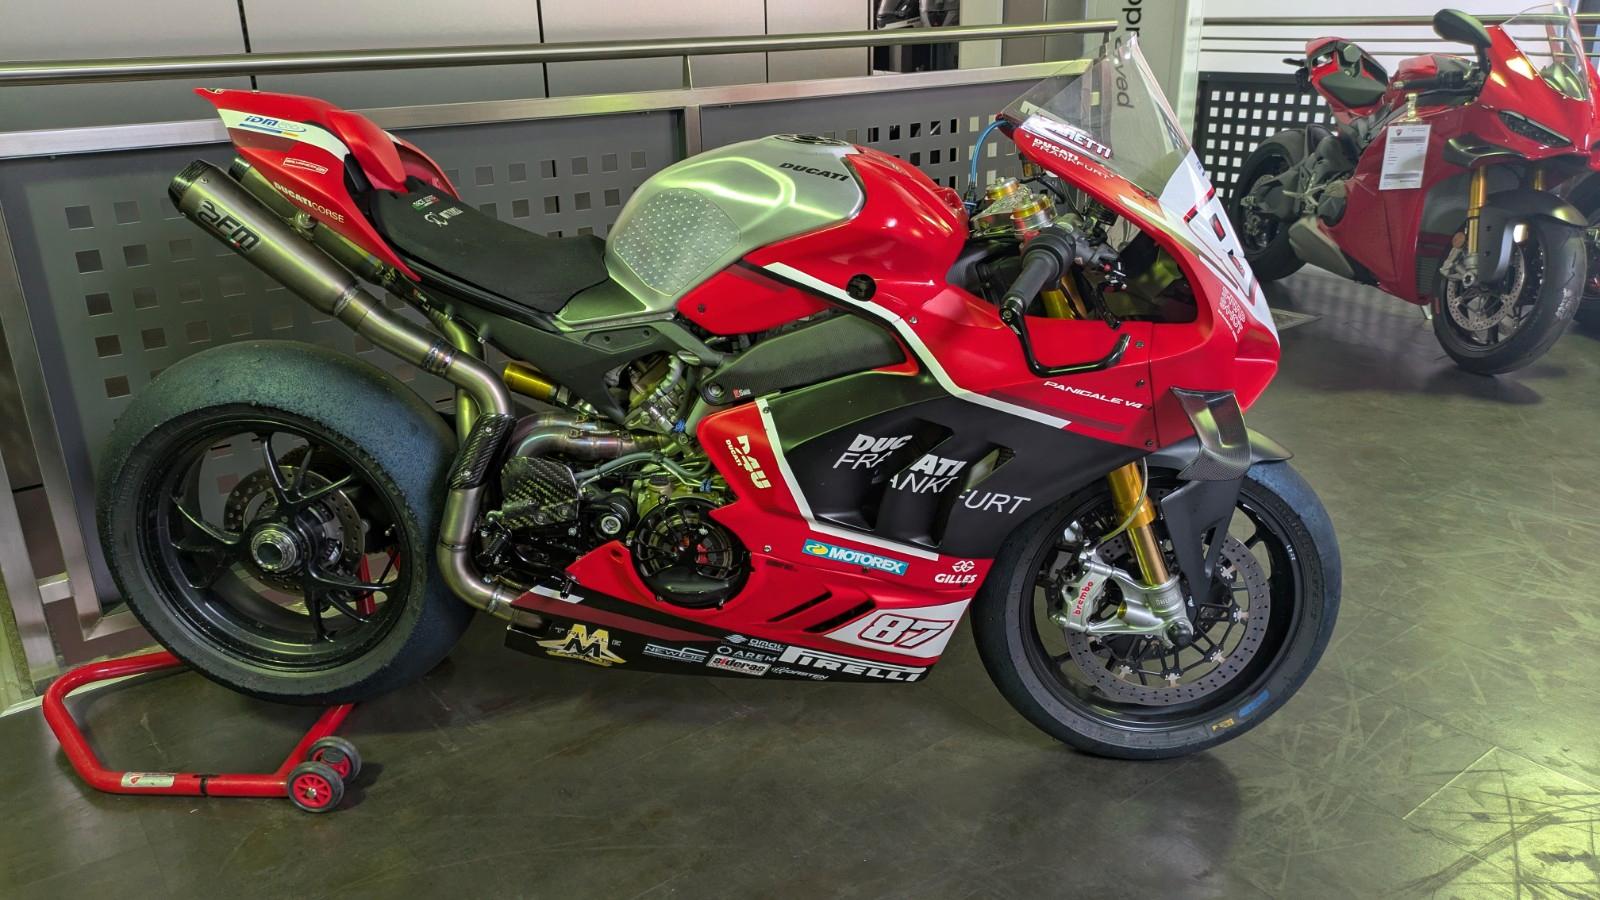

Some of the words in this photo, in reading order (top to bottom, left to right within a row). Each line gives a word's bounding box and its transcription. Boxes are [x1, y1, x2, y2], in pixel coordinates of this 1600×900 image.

[778, 162, 850, 182] DUCATI
[1043, 380, 1124, 405] PANIGALE
[1124, 400, 1144, 409] V4
[725, 439, 742, 467] DUCATI
[847, 433, 968, 477] DUCATI
[828, 547, 904, 574] MOTOREX
[934, 573, 978, 584] GILLES
[1072, 581, 1094, 616] brembo
[857, 613, 956, 650] 87
[778, 645, 928, 682] PIRELLI
